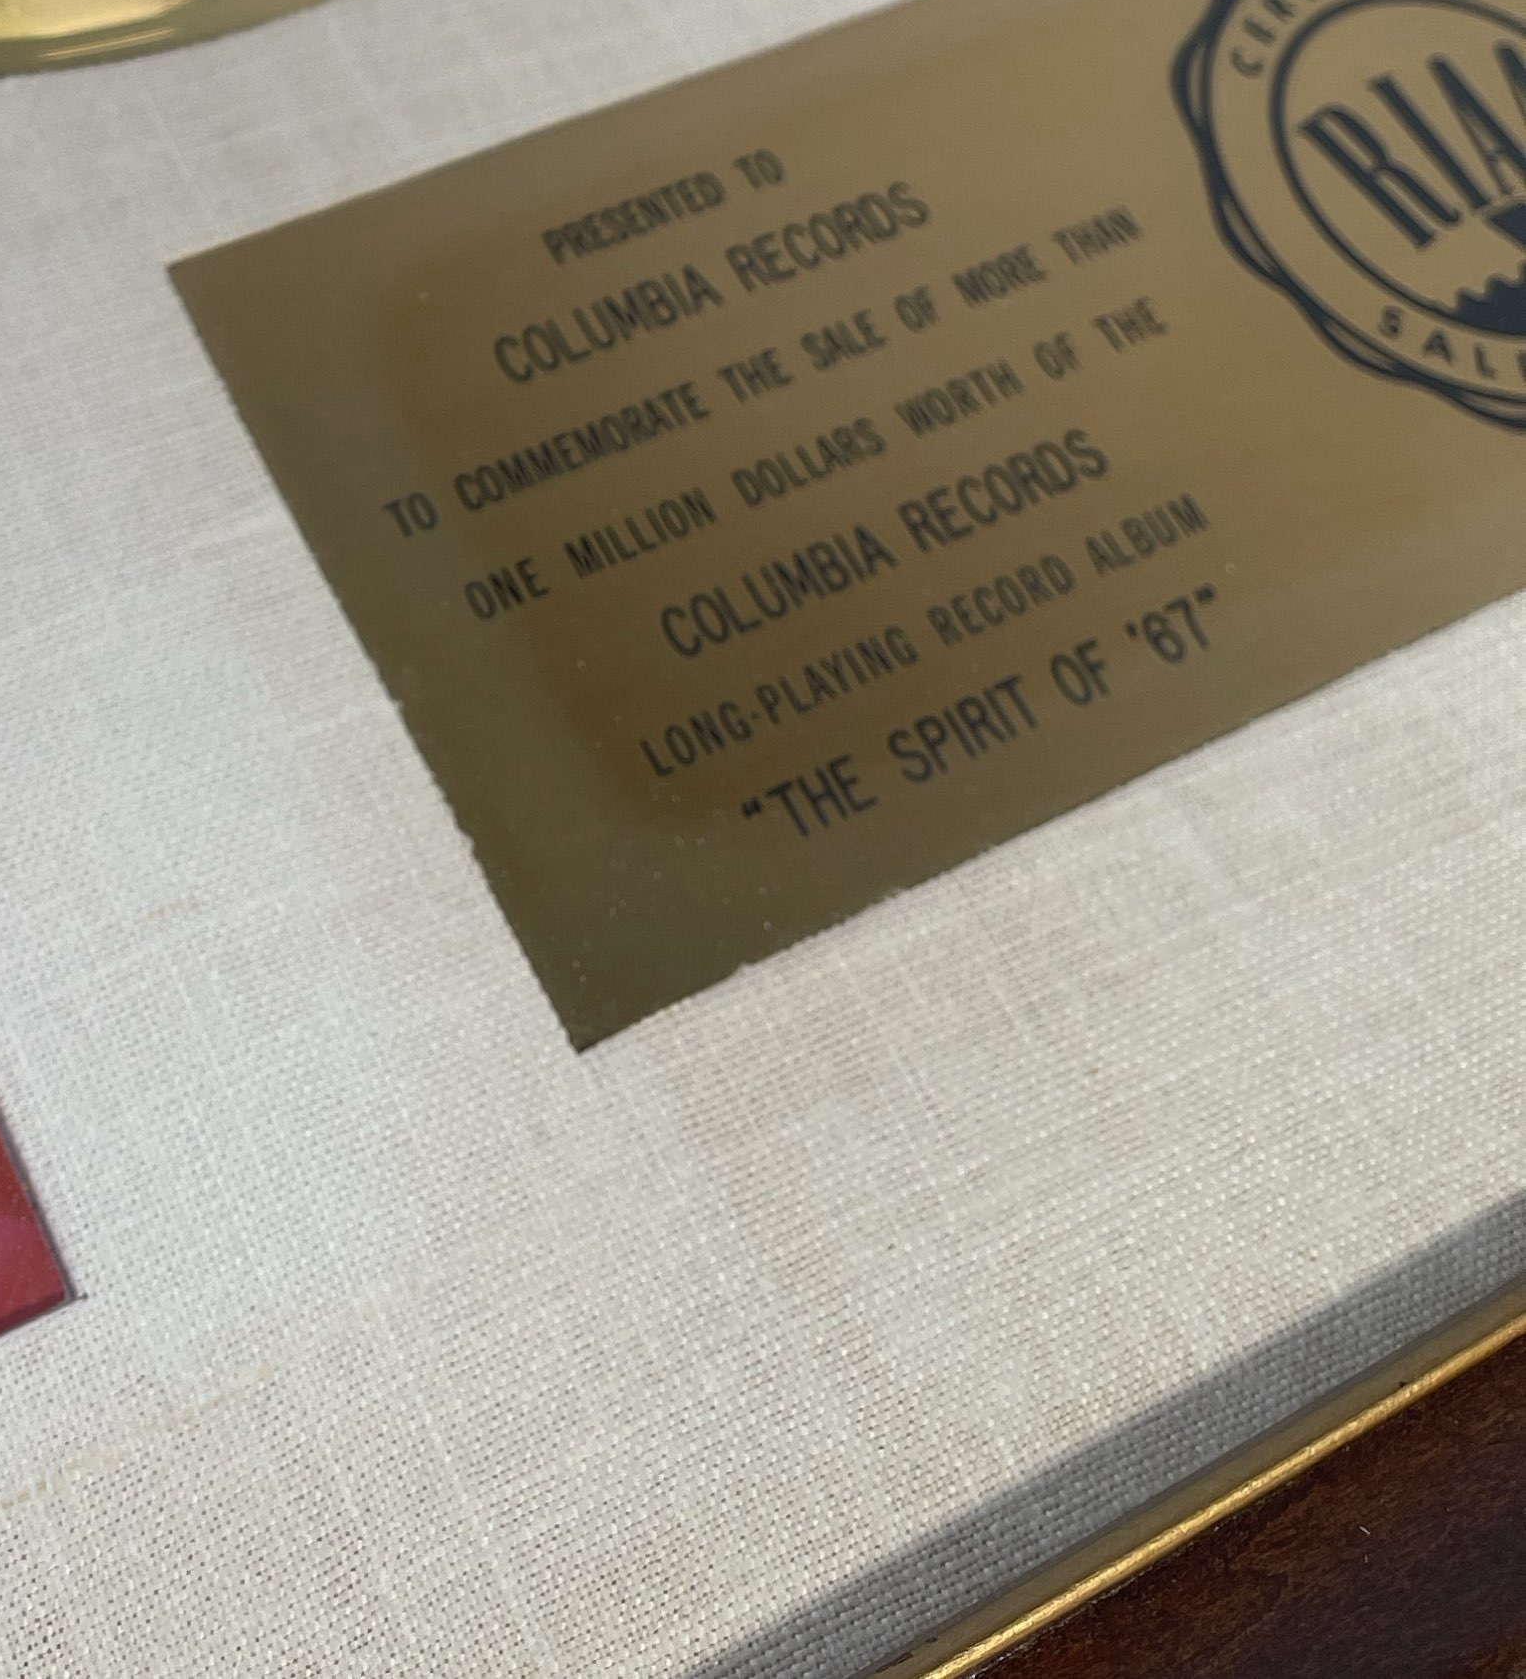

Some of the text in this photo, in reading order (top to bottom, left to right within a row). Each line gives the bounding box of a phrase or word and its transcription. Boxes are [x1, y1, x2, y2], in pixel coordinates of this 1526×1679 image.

[493, 180, 931, 383] COLUMBIA RECORDS
[542, 148, 786, 265] PRESENTED TO
[382, 205, 1143, 538] TO COMMEMORATE THE SALE OF MORE THAN
[464, 296, 1169, 620] ONE MILLION DOLLARS WORTH OF THE
[639, 493, 1211, 778] LONG-PLAYING RECORD ALBUM
[661, 428, 1110, 657] COLUMBIA RECORDS
[886, 674, 1040, 784] SPIRIT
[1048, 638, 1111, 708] OF
